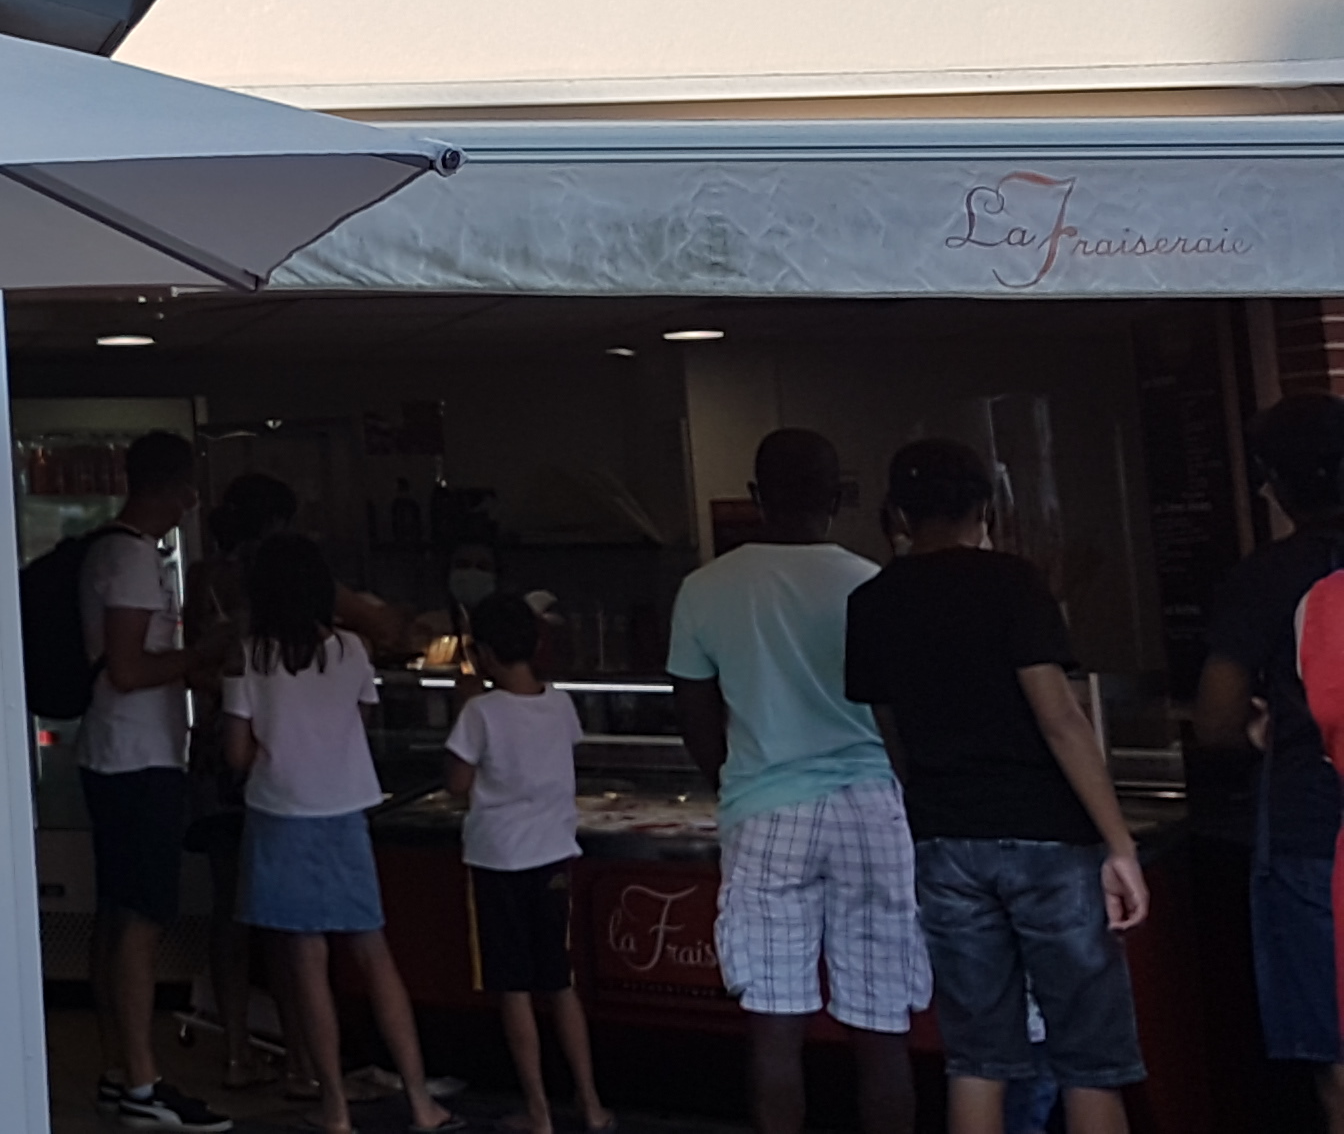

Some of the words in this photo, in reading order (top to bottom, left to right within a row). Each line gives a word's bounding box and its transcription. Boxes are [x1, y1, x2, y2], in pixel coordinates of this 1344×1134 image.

[945, 185, 1037, 249] La
[992, 171, 1254, 289] Fraiseraie
[621, 884, 719, 972] Frais
